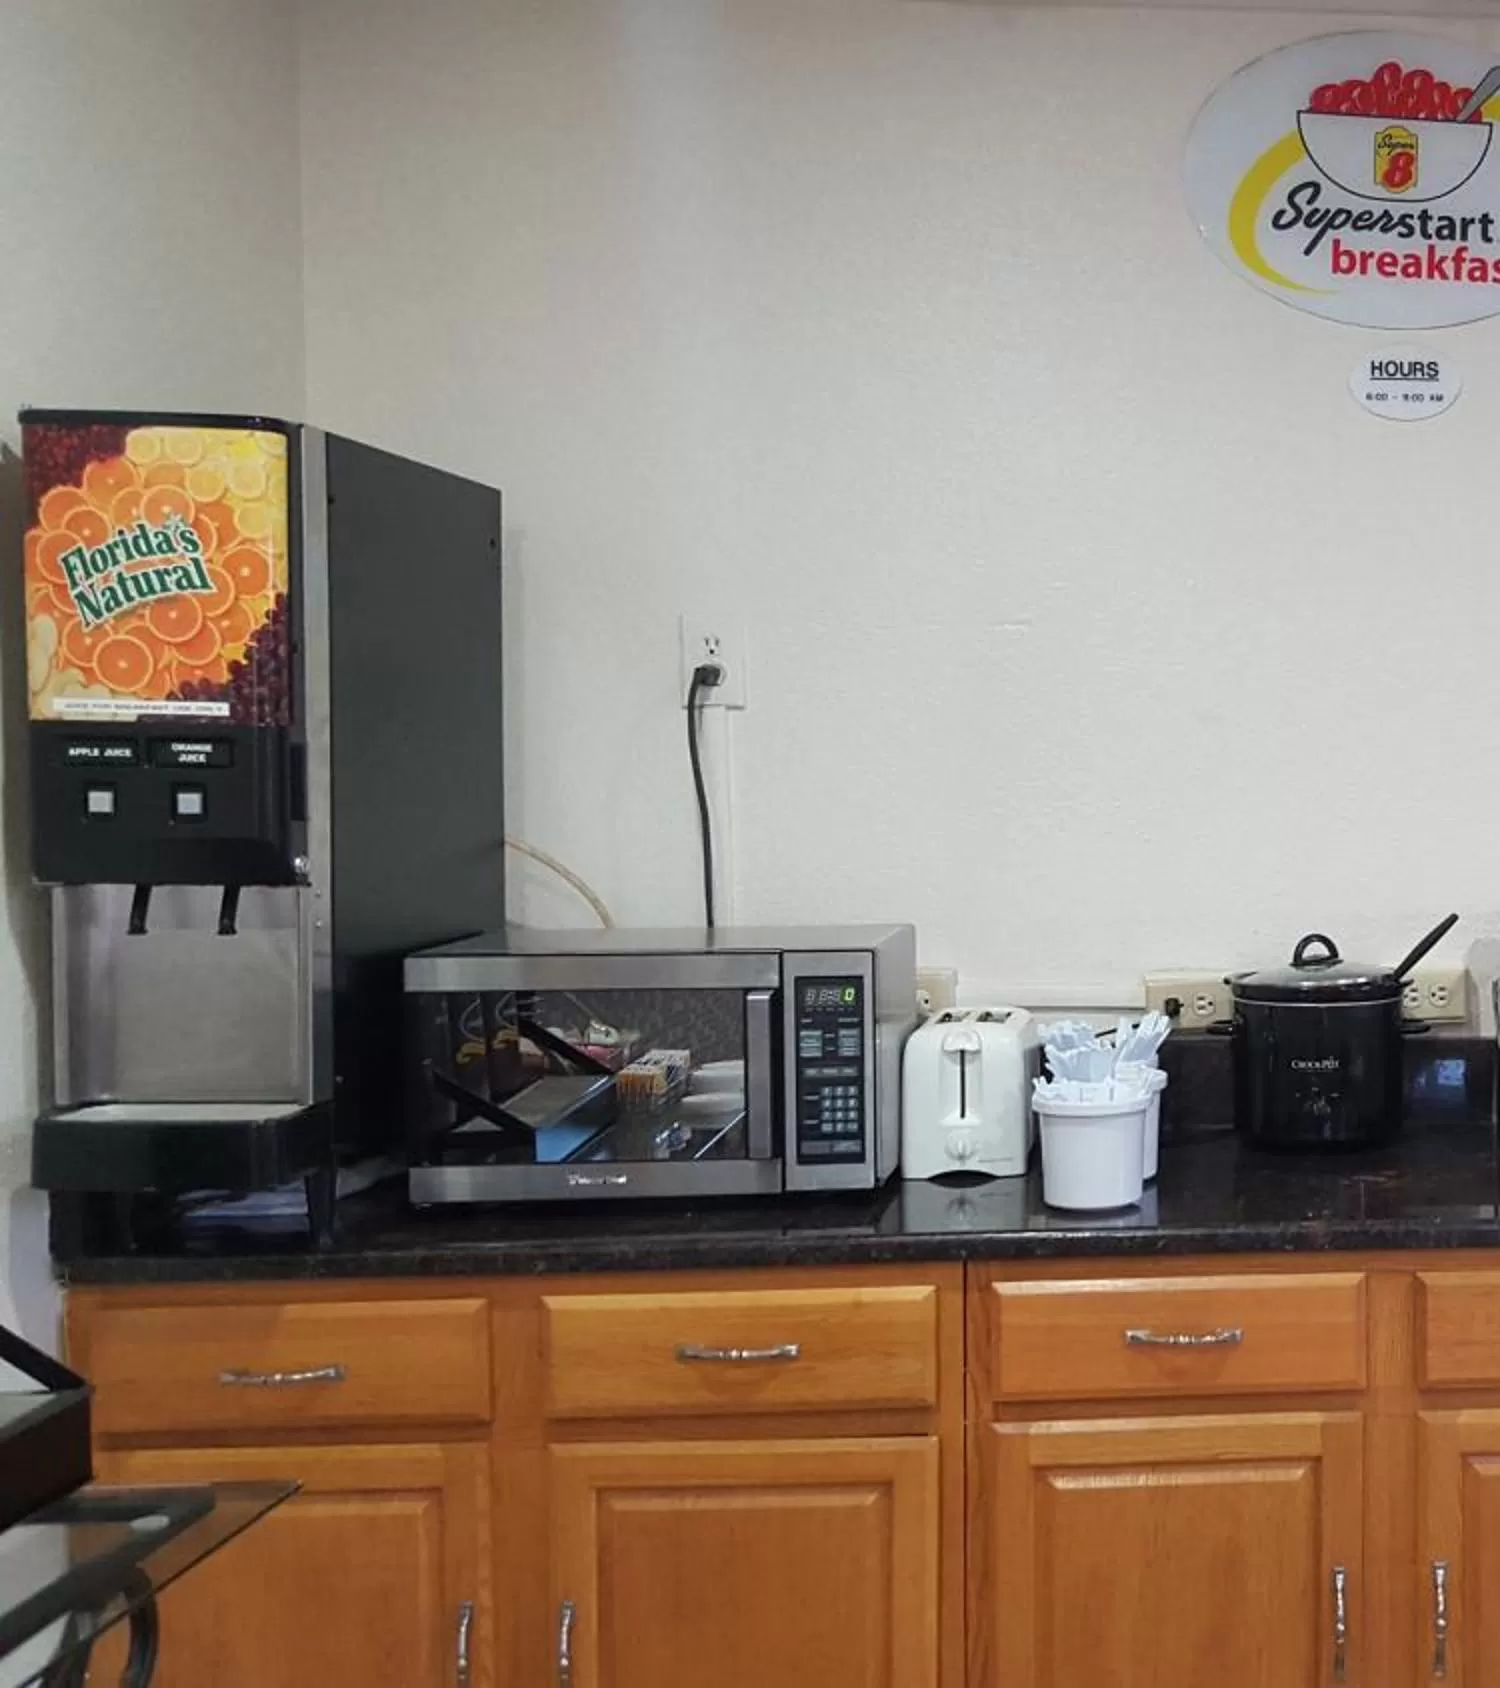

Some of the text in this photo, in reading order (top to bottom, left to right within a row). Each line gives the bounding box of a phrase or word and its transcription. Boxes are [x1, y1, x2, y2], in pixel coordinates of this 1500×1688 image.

[1383, 150, 1415, 189] 8
[1271, 181, 1495, 256] Superstart
[1370, 360, 1440, 378] HOURS
[60, 515, 200, 591] Florida's
[74, 556, 214, 629] Natural
[68, 747, 132, 758] APPLE JUICE
[178, 753, 207, 763] JUICE
